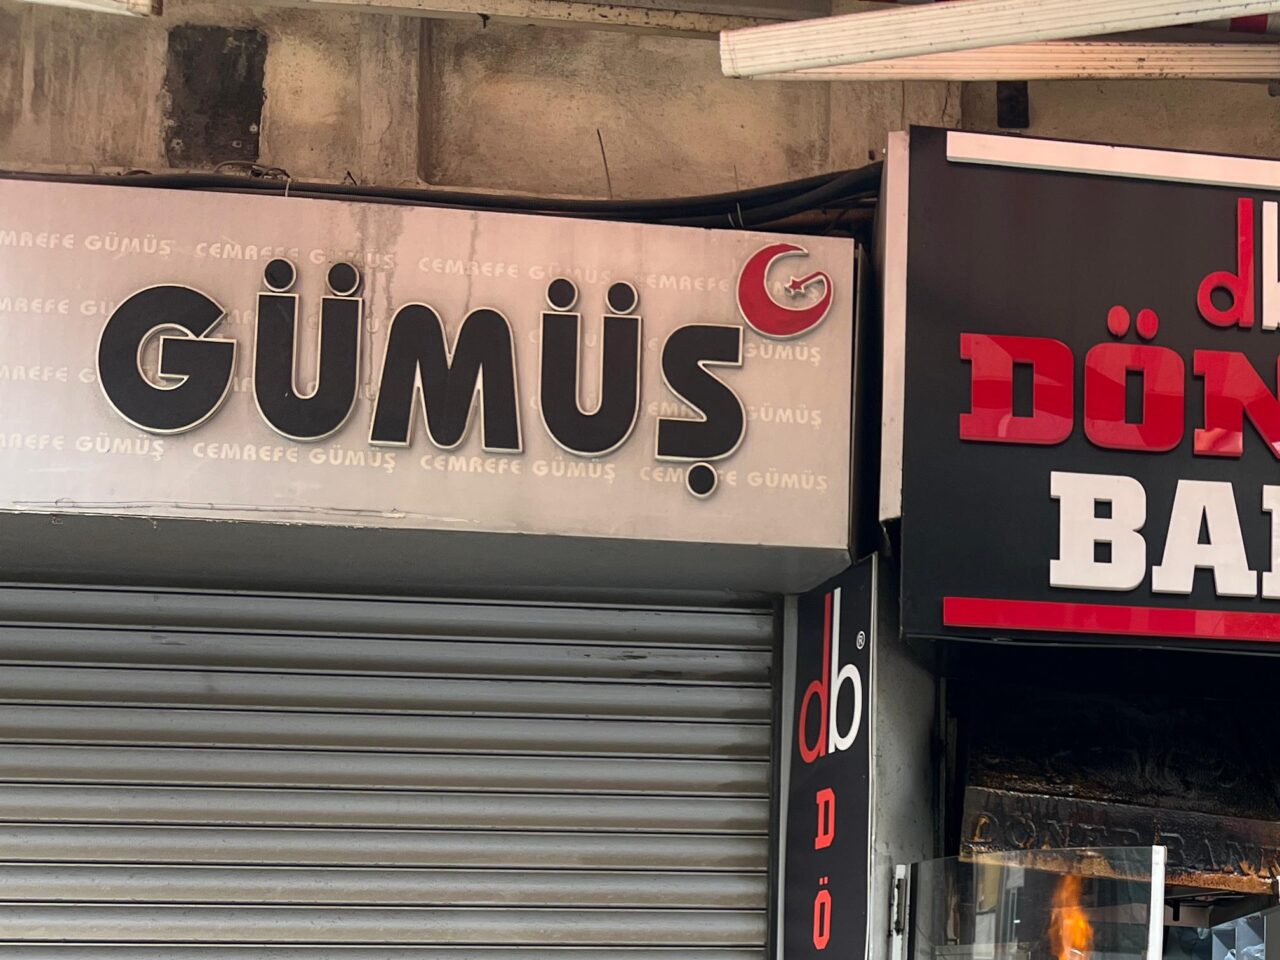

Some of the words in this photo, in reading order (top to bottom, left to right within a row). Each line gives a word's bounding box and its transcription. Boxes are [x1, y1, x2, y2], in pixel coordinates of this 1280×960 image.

[85, 232, 172, 259] GÜMÜŞ
[96, 257, 746, 498] GÜMÜŞ
[76, 432, 165, 461] GÜMÜŞ
[192, 442, 299, 463] CEMREFE
[309, 445, 396, 474] GÜMÜŞ
[420, 454, 522, 475] CEMREFE
[532, 456, 616, 485] GÜMÜŞ
[747, 468, 829, 494] GÜMÜŞ
[799, 587, 863, 763] db
